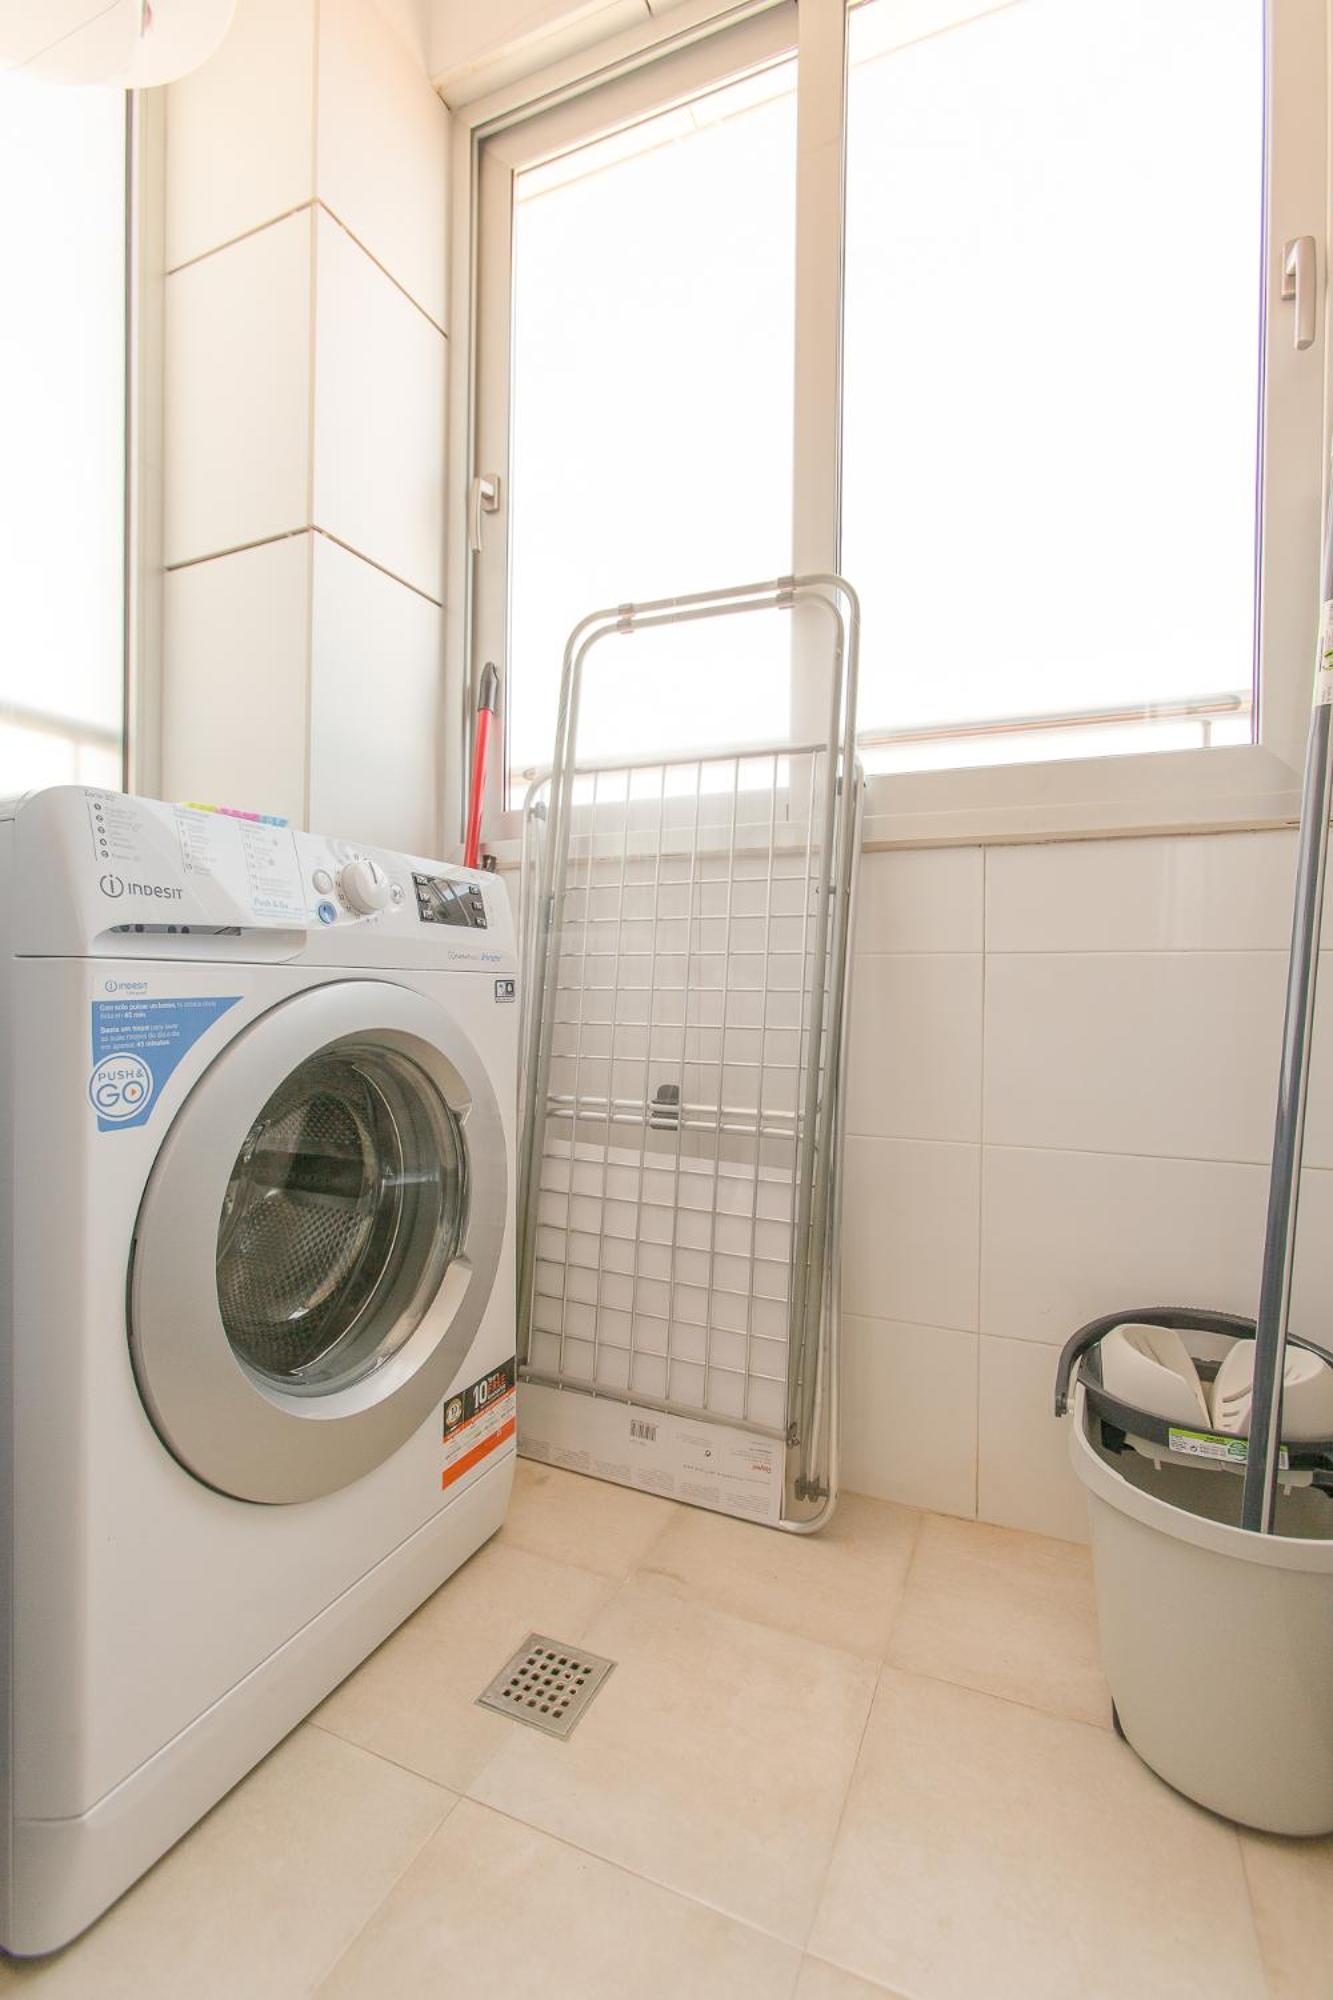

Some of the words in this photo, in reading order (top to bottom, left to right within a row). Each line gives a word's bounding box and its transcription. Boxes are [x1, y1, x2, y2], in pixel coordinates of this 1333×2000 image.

[128, 882, 183, 900] INDESIT
[96, 1081, 145, 1107] GO
[473, 1379, 488, 1409] 10
